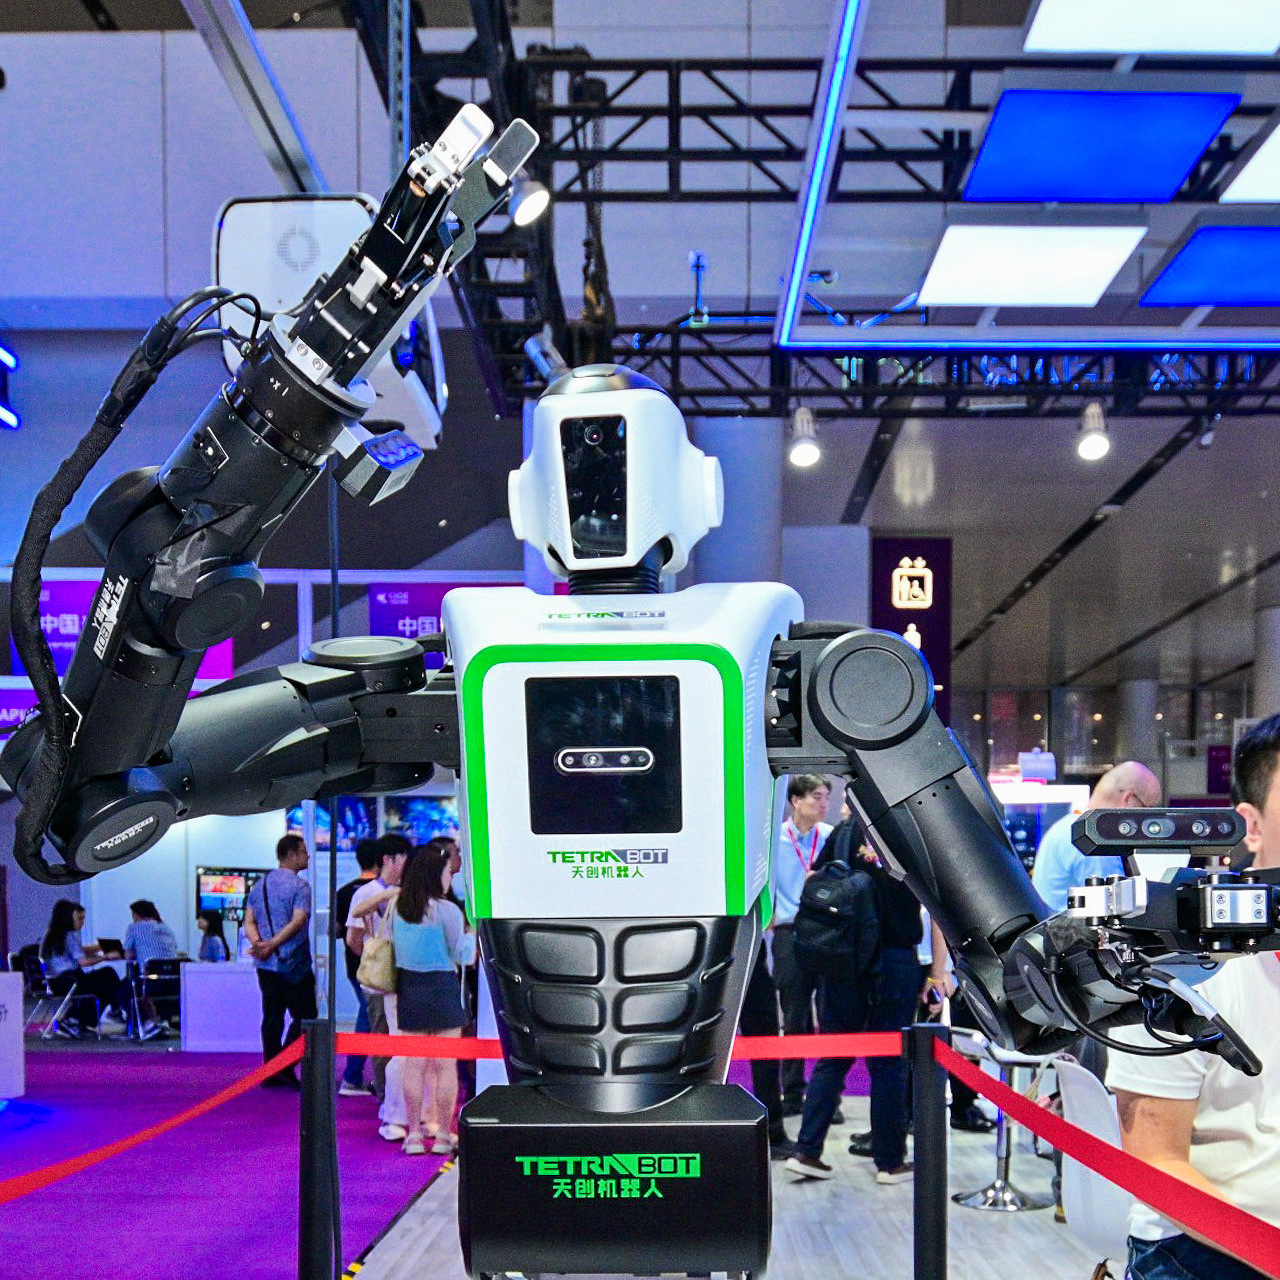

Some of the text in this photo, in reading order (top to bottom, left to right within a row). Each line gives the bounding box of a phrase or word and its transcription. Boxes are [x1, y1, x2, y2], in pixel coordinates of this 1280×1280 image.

[40, 613, 86, 634] 中国
[547, 849, 668, 864] TETRABOT
[572, 866, 644, 878] 天创机器人
[515, 1153, 700, 1178] TETRABOT
[552, 1179, 663, 1198] 天创机器人
